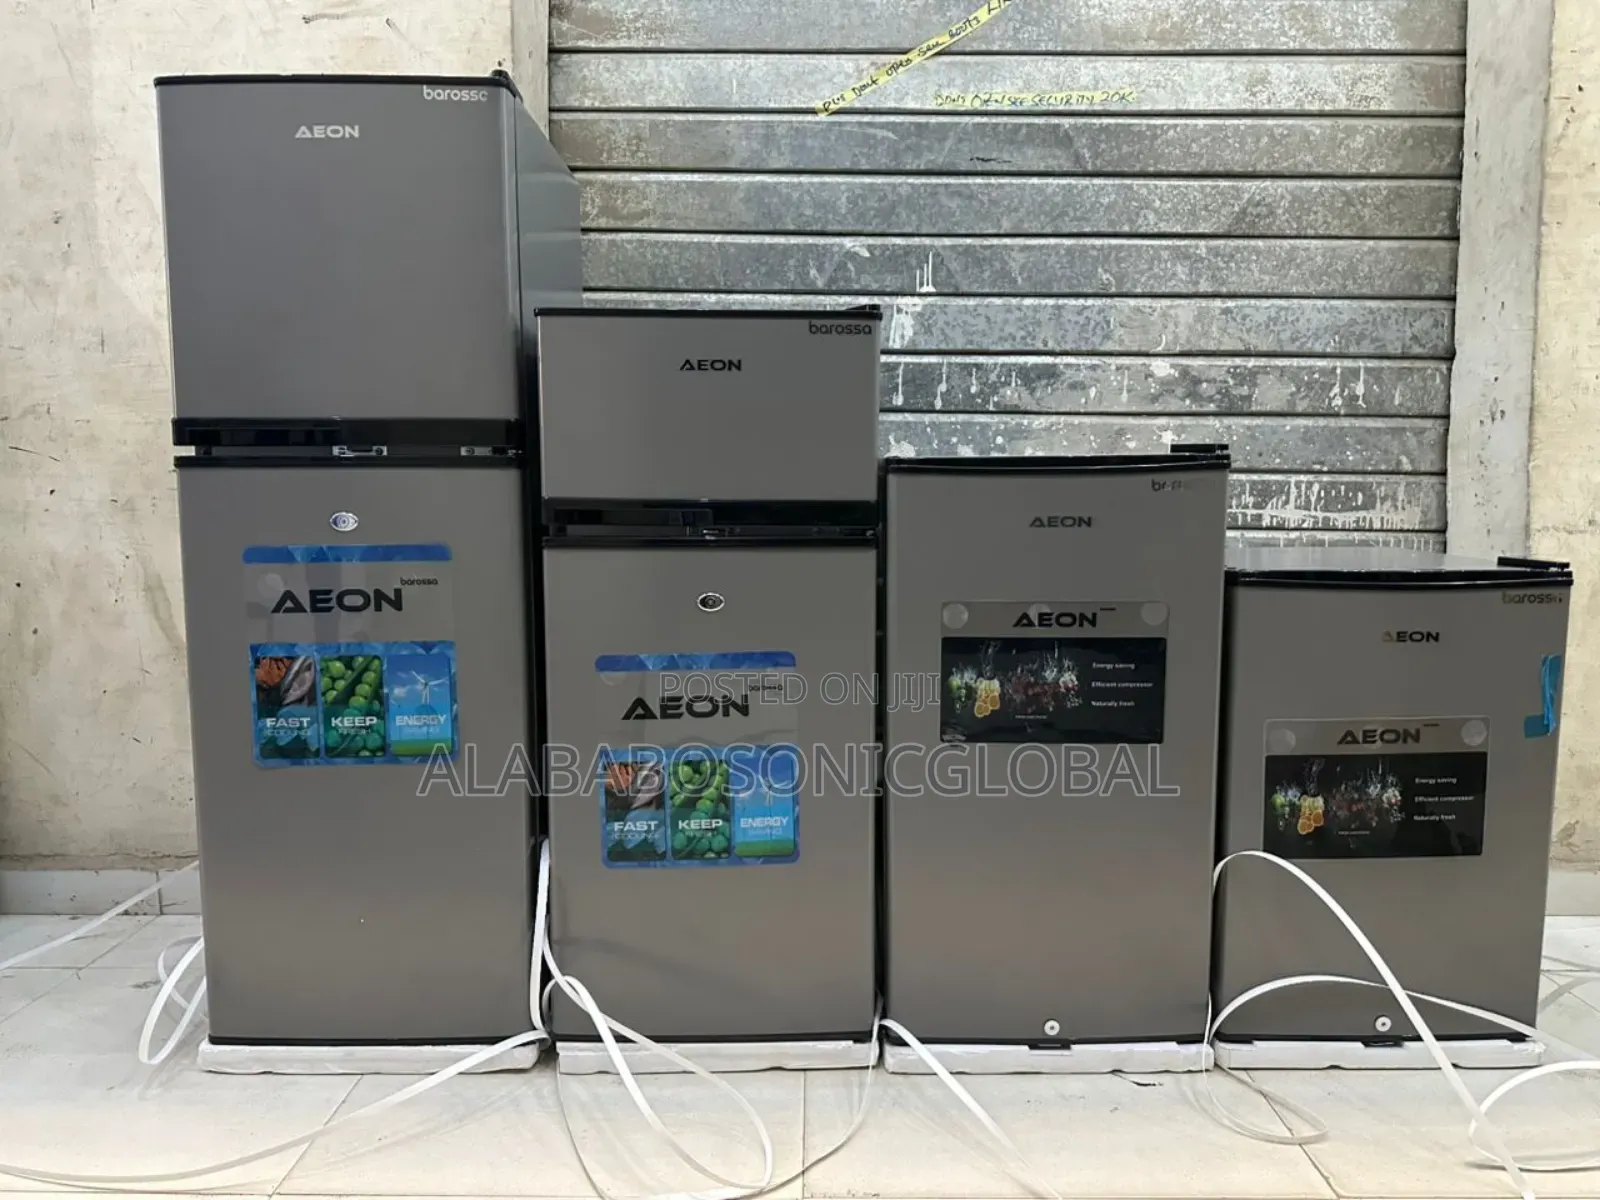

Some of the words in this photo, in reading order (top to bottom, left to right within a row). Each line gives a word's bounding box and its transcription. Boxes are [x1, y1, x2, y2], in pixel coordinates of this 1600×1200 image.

[295, 125, 360, 139] AEON
[809, 321, 873, 336] barossa
[680, 359, 743, 372] AEON
[1029, 516, 1093, 528] AEON
[400, 576, 439, 587] barossa
[271, 588, 404, 614] AEON
[1013, 612, 1098, 628] AEON
[1382, 630, 1441, 644] AEON
[621, 694, 750, 721] AEON
[265, 717, 311, 728] FAST
[331, 716, 378, 727] KEEP
[395, 714, 447, 726] ENERGY
[1337, 728, 1421, 745] AEON
[614, 821, 659, 832] FAST
[678, 818, 723, 830] KEEP
[740, 816, 789, 828] ENERGY
